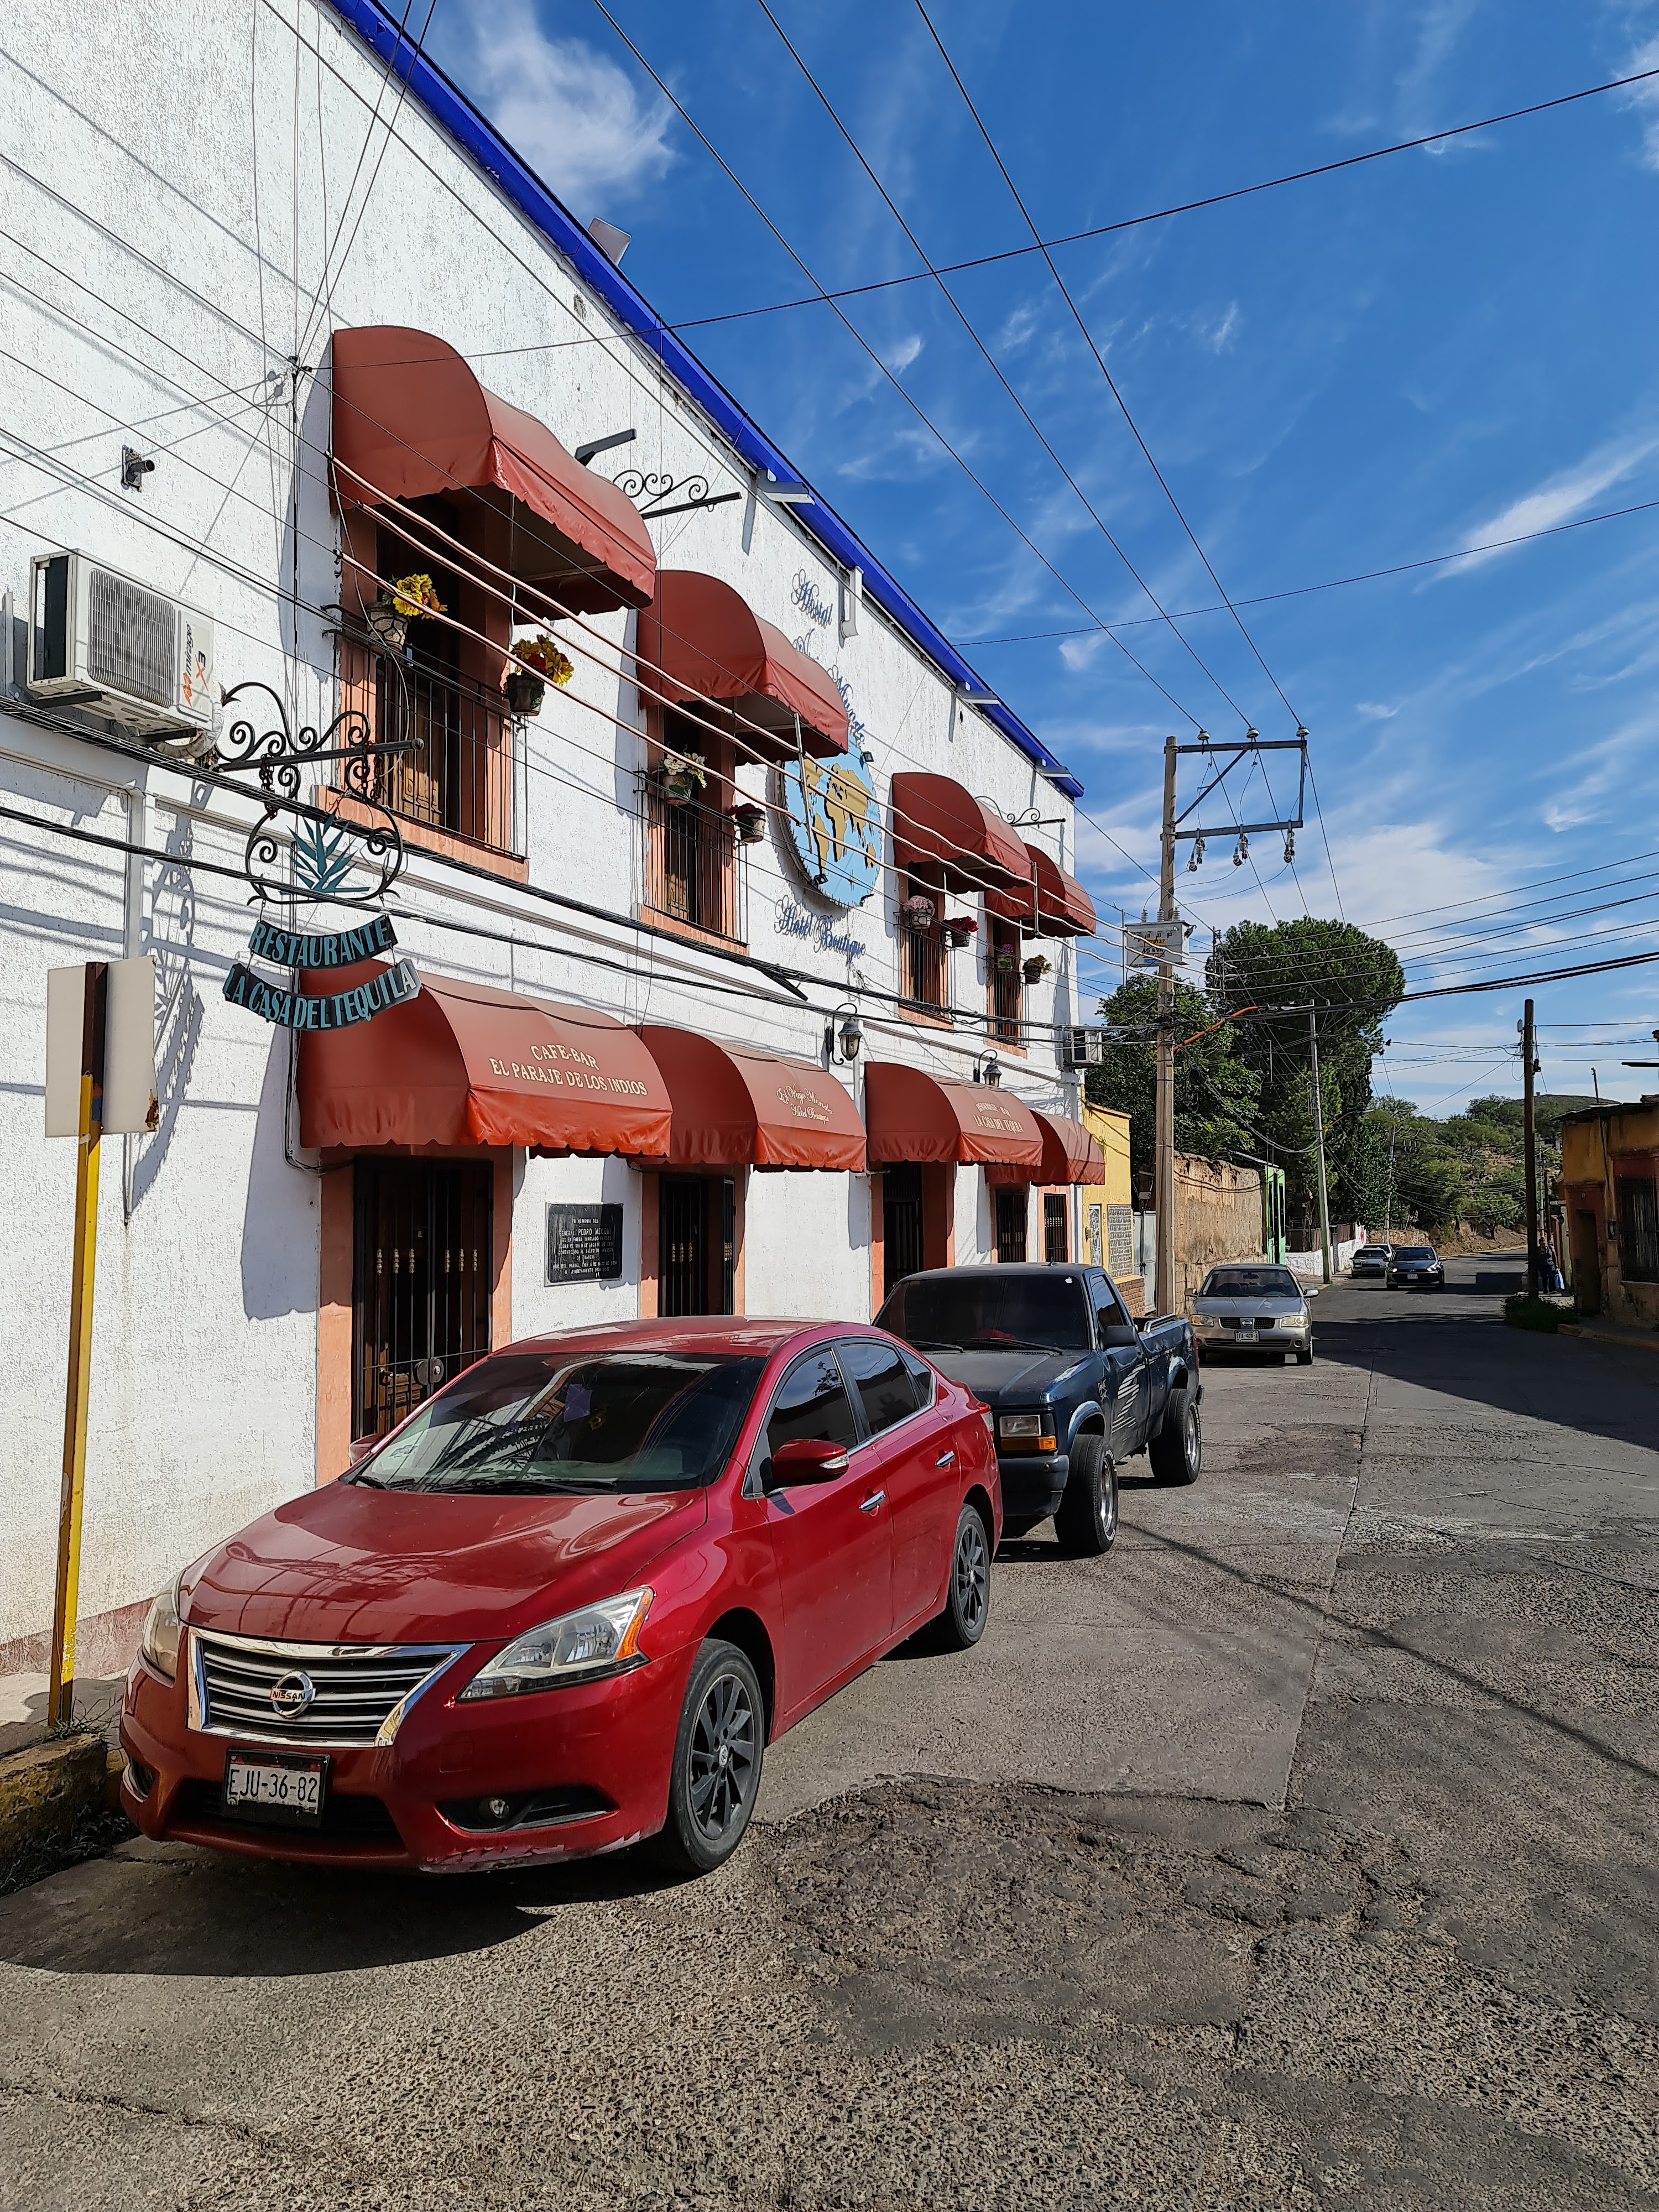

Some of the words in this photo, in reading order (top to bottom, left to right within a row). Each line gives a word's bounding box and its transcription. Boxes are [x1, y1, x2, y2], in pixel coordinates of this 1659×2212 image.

[185, 623, 194, 677] mirage
[249, 916, 391, 967] RESTAURANTE
[774, 895, 813, 941] Hotel
[813, 915, 865, 964] Boutique
[223, 967, 246, 1005] LA
[248, 982, 290, 1025] CASA
[293, 998, 331, 1030] DEL
[331, 962, 416, 1022] TEQUILA
[489, 1057, 510, 1077] EL
[511, 1062, 563, 1086] PARAJE
[565, 1071, 584, 1088] DE
[583, 1073, 608, 1092] LOS
[608, 1078, 648, 1095] INDIOS
[530, 1044, 599, 1070] CAFE-BAR
[973, 1115, 984, 1127] LA
[981, 1115, 997, 1129] CASA
[993, 1118, 1006, 1131] DEL
[1003, 1119, 1024, 1134] TEQUILA
[272, 1691, 305, 1700] NISSAN
[229, 1769, 317, 1803] EJU-36-82
